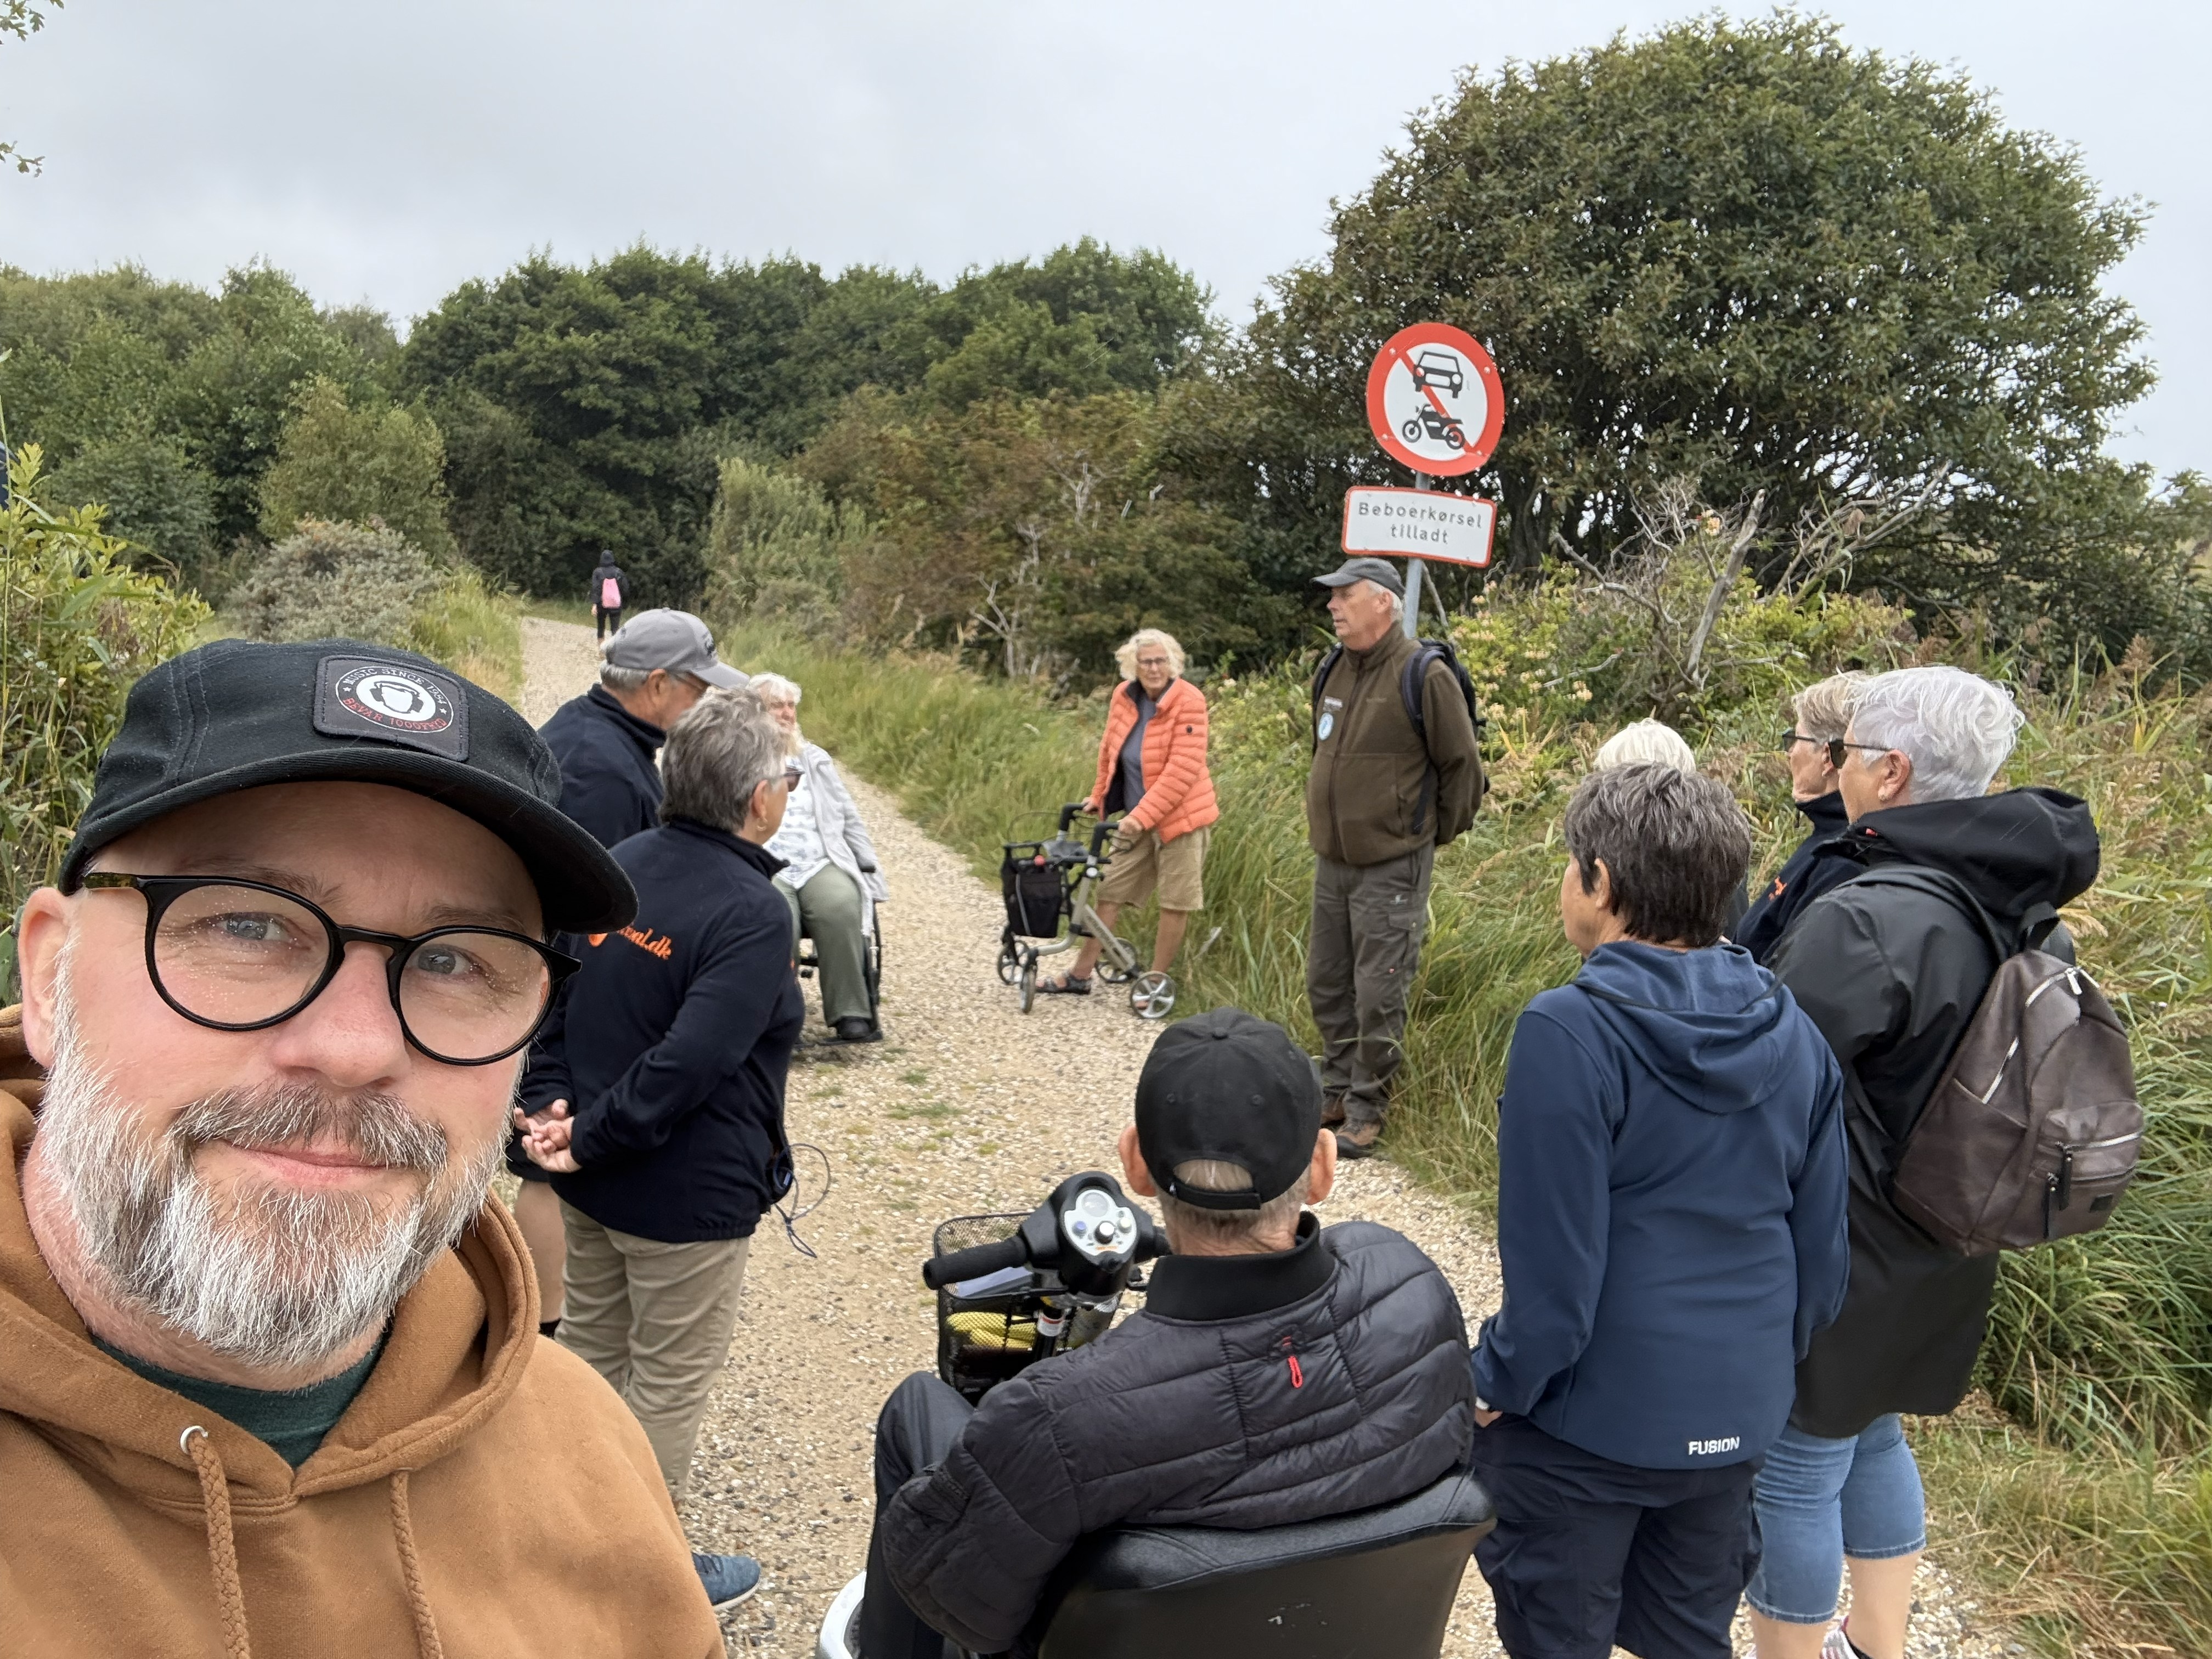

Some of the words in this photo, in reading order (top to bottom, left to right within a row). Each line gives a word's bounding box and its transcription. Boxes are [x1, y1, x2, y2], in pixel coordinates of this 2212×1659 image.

[1358, 502, 1482, 528] Beboerkørsel
[1391, 524, 1448, 544] tilladt
[342, 668, 377, 686] MUSIC
[382, 668, 425, 685] SINCE
[426, 685, 448, 704] 1984
[1688, 1436, 1740, 1455] FUSION
